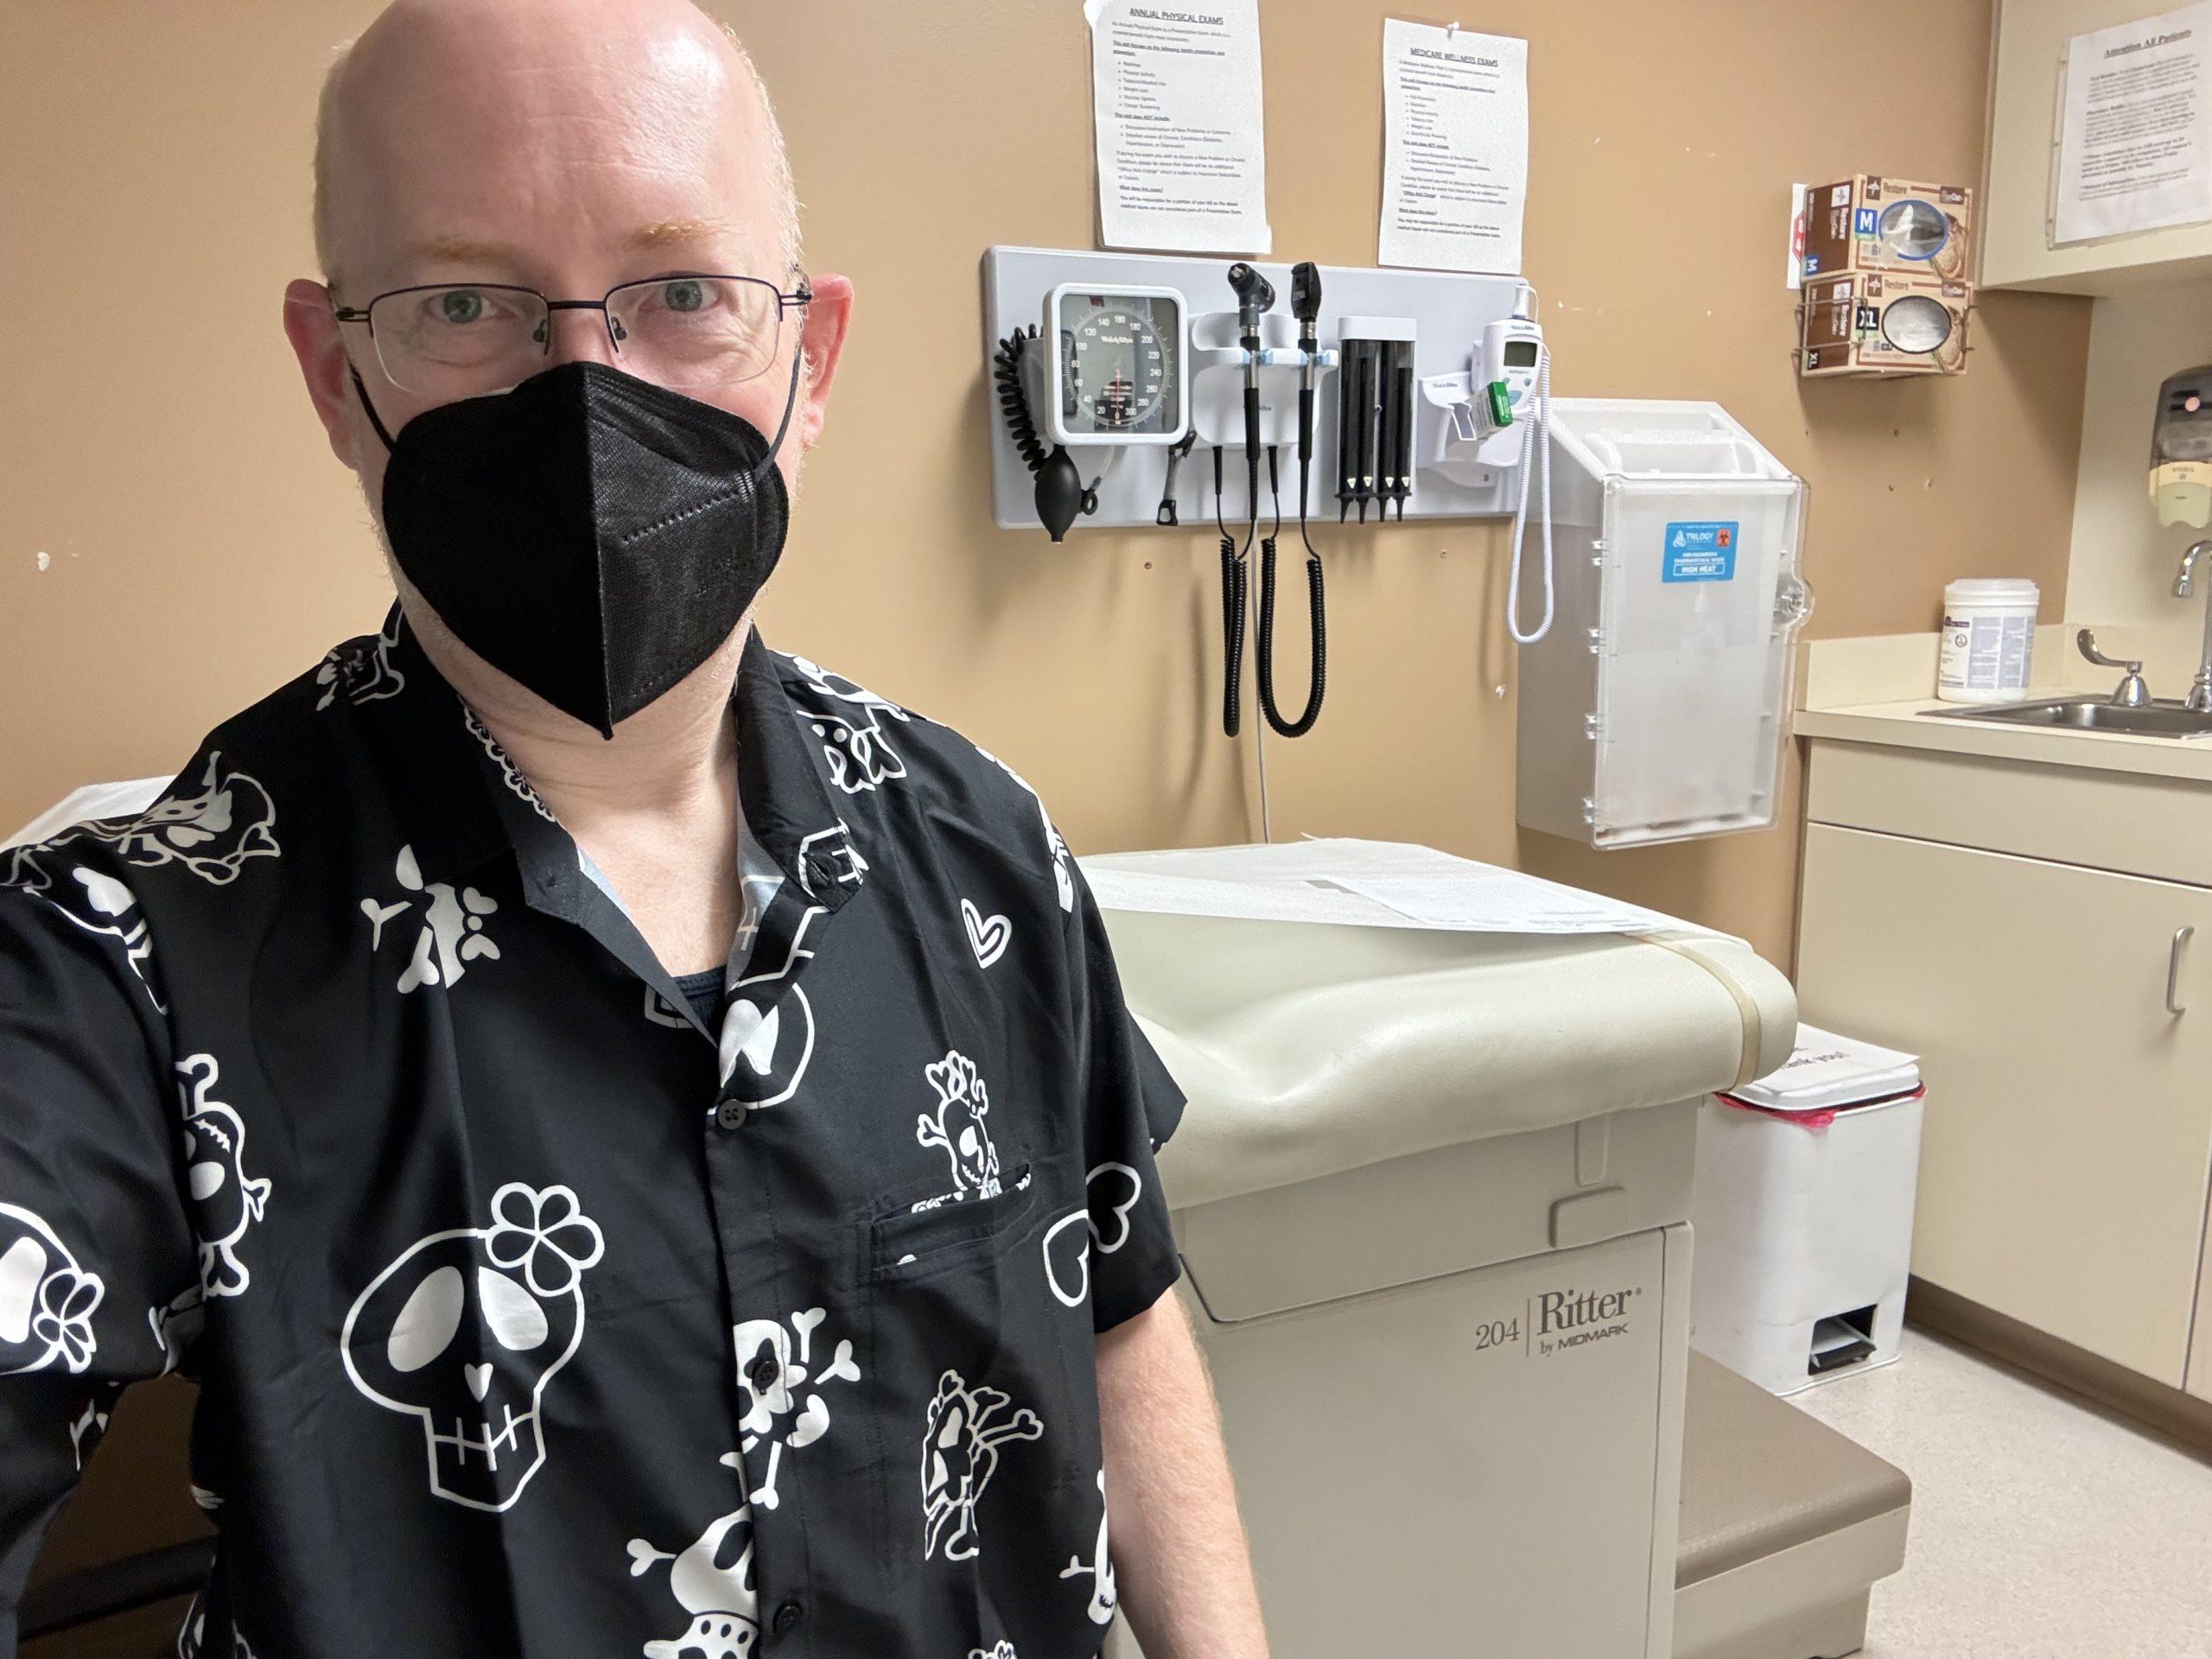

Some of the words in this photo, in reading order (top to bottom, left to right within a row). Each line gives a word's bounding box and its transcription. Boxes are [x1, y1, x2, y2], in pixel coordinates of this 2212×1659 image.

[1129, 8, 1159, 19] ANNUAL
[1161, 11, 1197, 22] PHYSICAL
[1198, 15, 1224, 25] EXAMS
[1410, 48, 1443, 59] MEDICARE
[1478, 57, 1498, 67] EXAMS
[1859, 211, 1873, 232] M
[1098, 318, 1109, 327] 140
[1859, 310, 1877, 327] XL
[1147, 351, 1160, 359] 220
[1150, 368, 1161, 377] 240
[1097, 406, 1106, 415] 20
[1686, 532, 1714, 541] TRILOGY
[1475, 1318, 1520, 1351] 204
[1537, 1289, 1632, 1336] Ritter
[1541, 1341, 1554, 1357] by
[1558, 1323, 1629, 1350] MIDMARK
